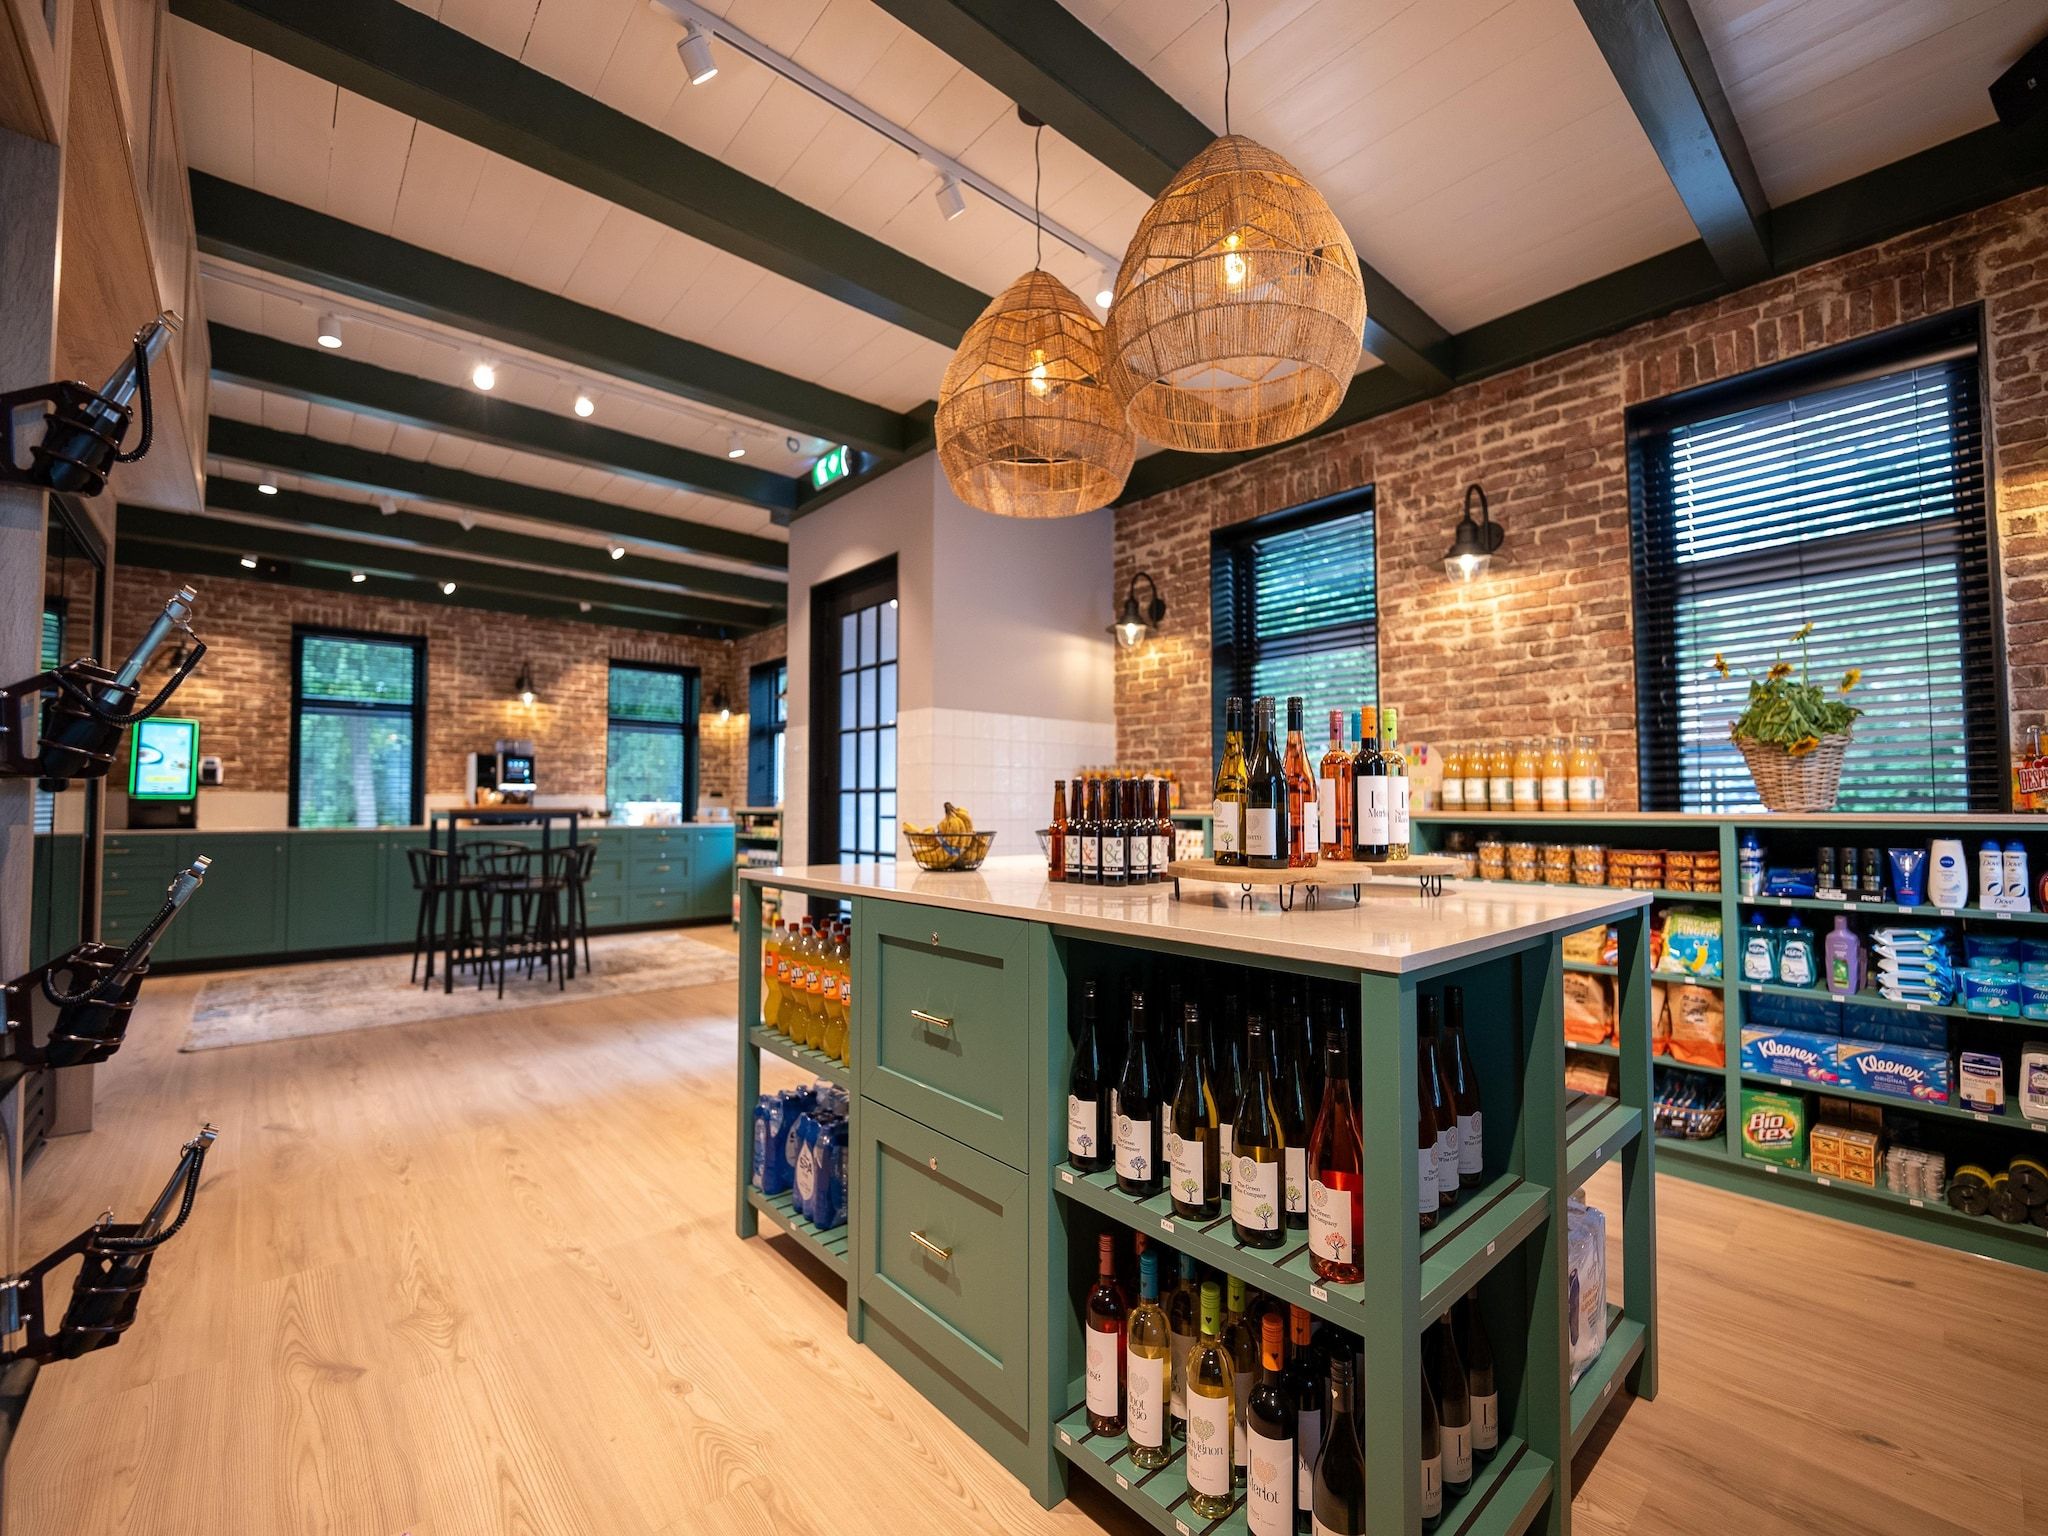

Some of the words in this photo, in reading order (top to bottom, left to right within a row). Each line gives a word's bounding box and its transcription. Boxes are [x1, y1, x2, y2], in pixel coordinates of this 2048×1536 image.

[1976, 986, 2008, 995] always
[1757, 1039, 1817, 1066] Kleenex
[1856, 1054, 1924, 1083] Kleenex
[1874, 1075, 1907, 1086] ORIGINAL
[1749, 1111, 1785, 1131] Bio
[1758, 1127, 1795, 1141] tex
[1243, 1190, 1267, 1200] Company
[1245, 1184, 1261, 1192] Green
[1314, 1214, 1338, 1228] Company
